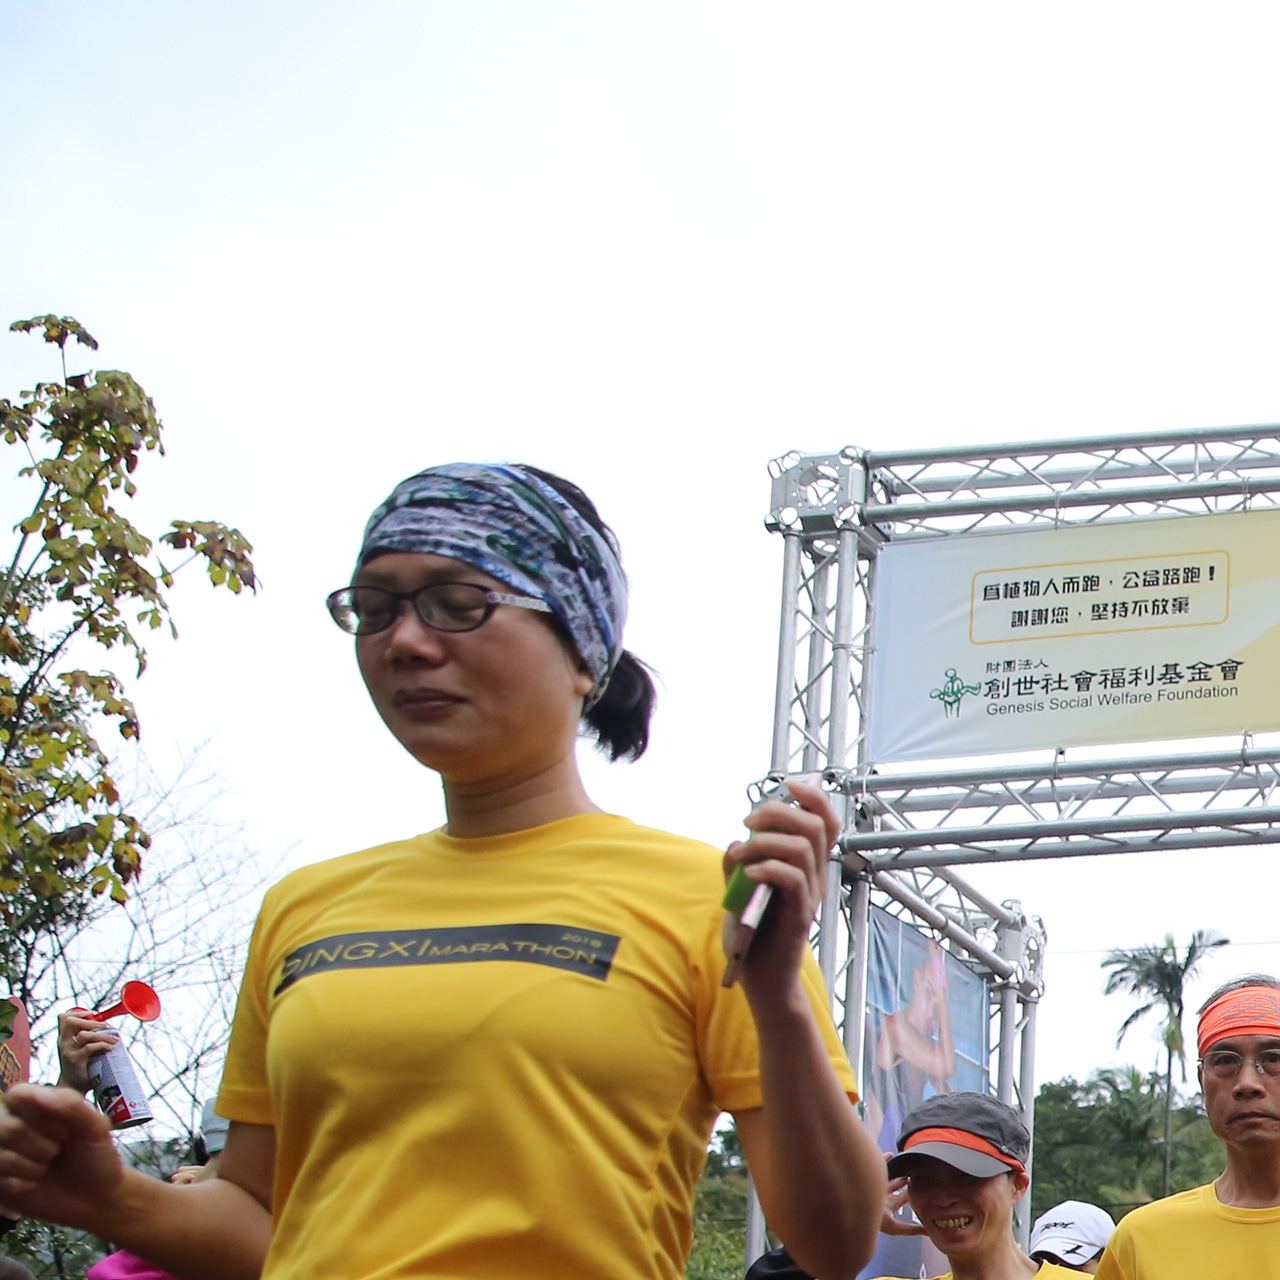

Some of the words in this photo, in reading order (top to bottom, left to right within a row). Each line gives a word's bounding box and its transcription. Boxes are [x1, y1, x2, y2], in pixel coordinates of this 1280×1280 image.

[984, 658, 1244, 699] 創世社會福利基金會
[986, 658, 1049, 674] 財團法人
[986, 702, 1044, 716] Genesis
[1049, 697, 1093, 711] Social
[1097, 691, 1152, 706] Welfare
[1157, 685, 1239, 702] Foundation
[428, 940, 598, 966] MARATHON
[561, 932, 602, 948] 2018
